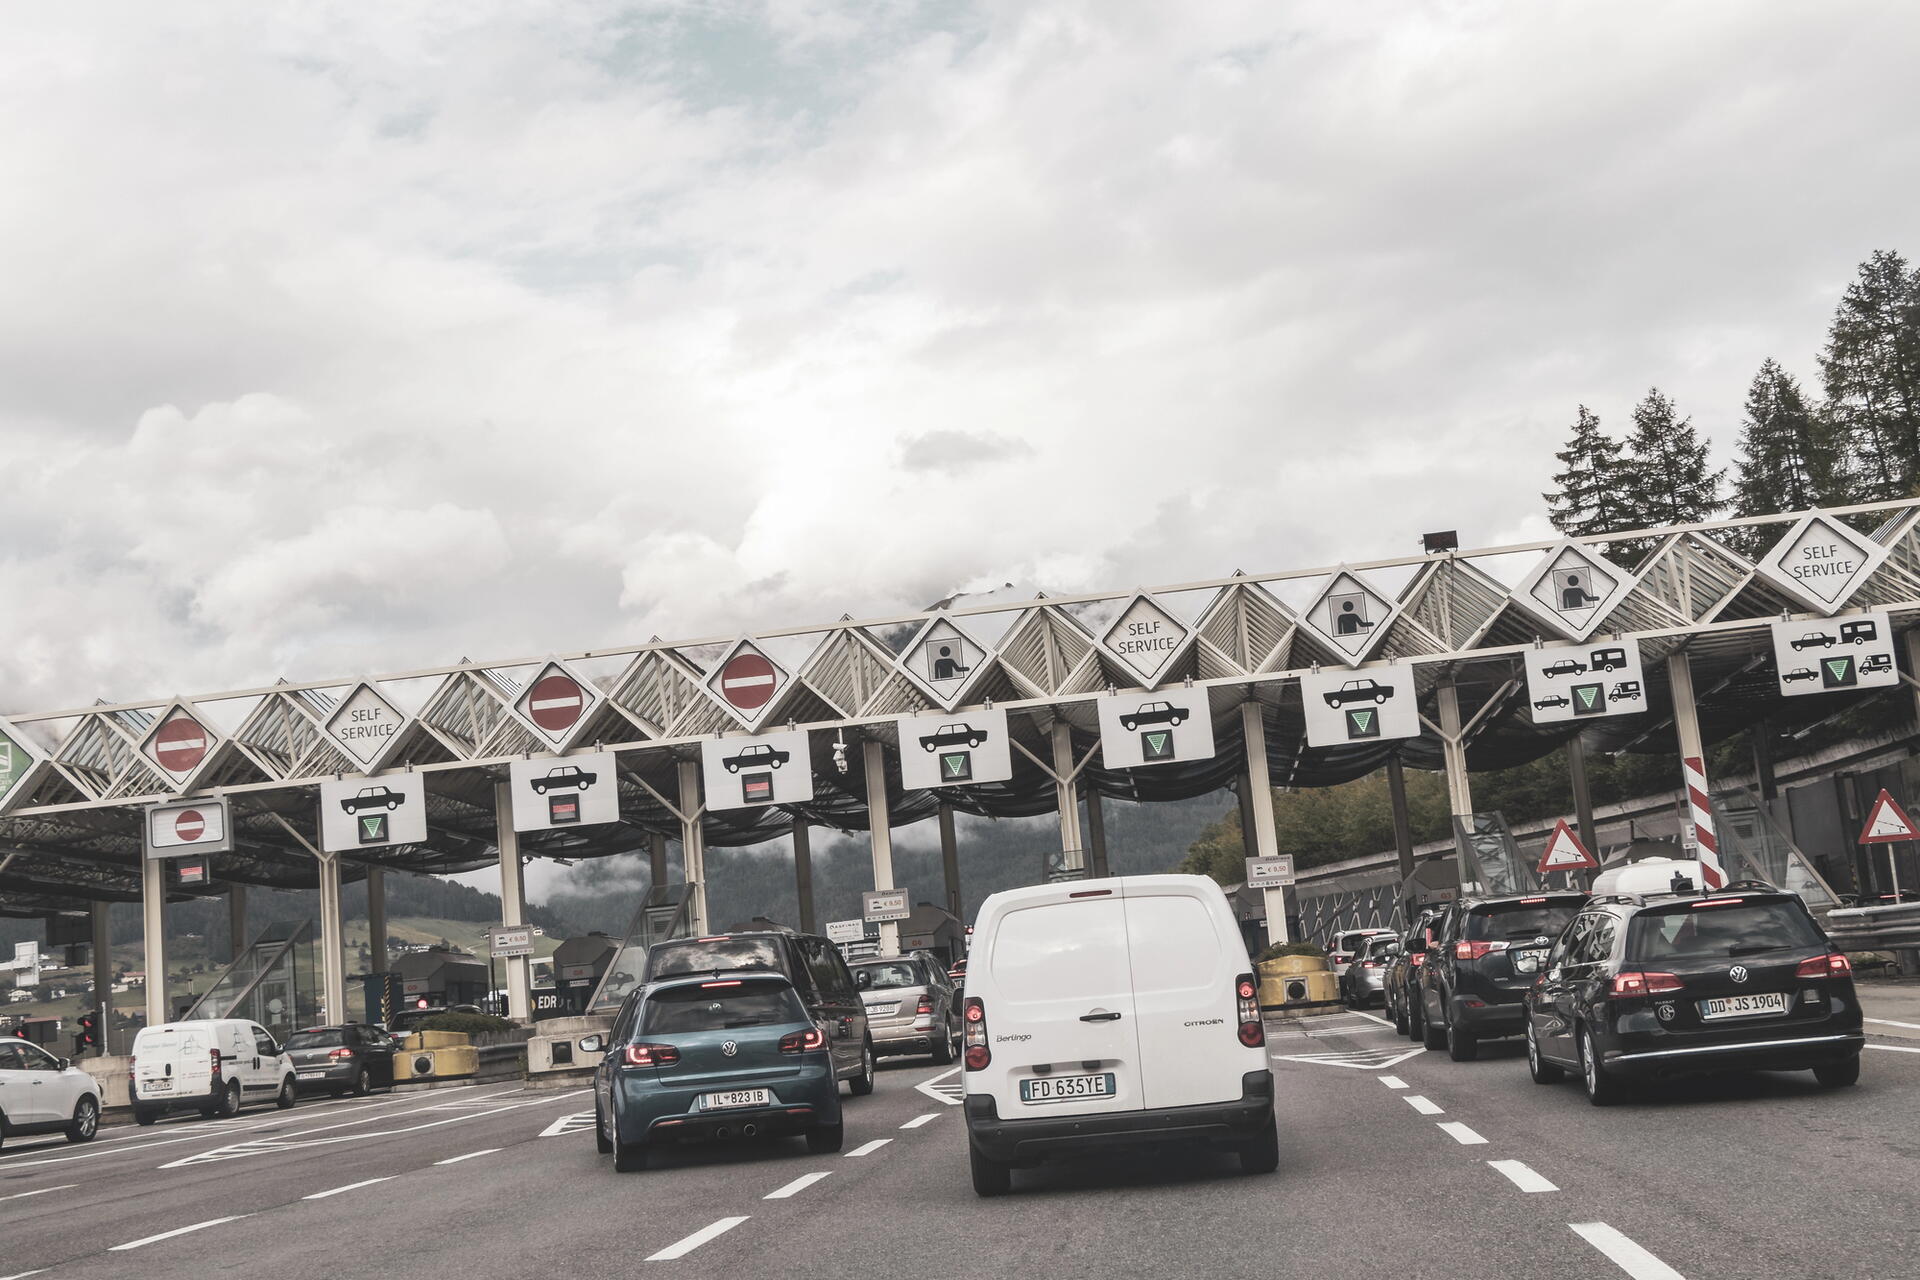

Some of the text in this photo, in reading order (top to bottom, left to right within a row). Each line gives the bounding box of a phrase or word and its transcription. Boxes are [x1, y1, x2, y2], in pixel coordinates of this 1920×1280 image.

[1803, 544, 1838, 560] SELF
[1793, 560, 1854, 579] SERVICE
[1128, 620, 1161, 636] SELF
[1118, 636, 1175, 655] SERVICE
[351, 707, 381, 723] SELF
[341, 723, 393, 741] SERVICE
[1709, 994, 1782, 1014] DD JS 1904
[996, 1034, 1032, 1043] Berlingo
[1031, 1076, 1104, 1098] FD 635YE
[713, 1090, 764, 1105] IL 823 IB
